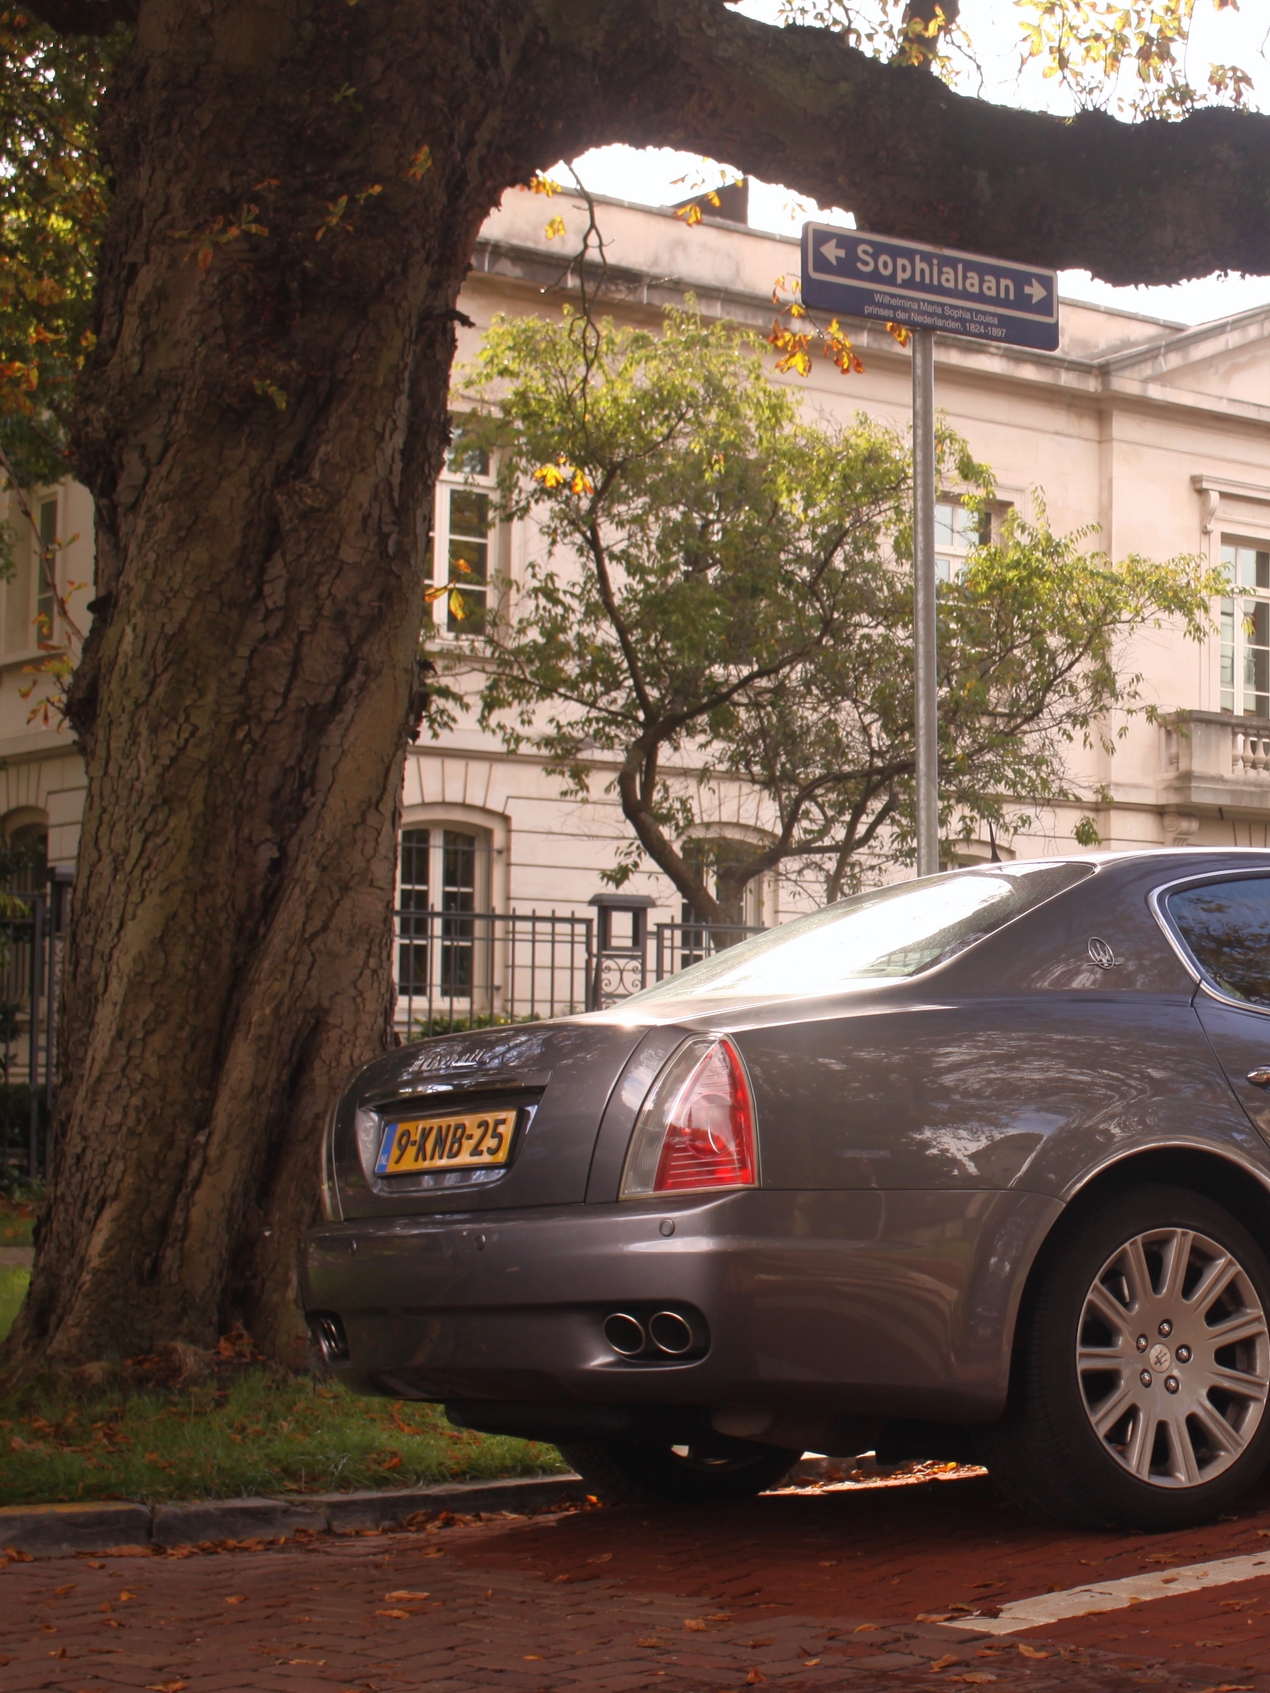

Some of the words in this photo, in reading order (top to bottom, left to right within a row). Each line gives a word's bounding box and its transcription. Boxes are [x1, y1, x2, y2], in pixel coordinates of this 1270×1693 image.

[856, 244, 1015, 301] Sophialaan
[864, 304, 894, 318] prinses
[895, 310, 910, 320] der
[911, 311, 964, 332] Nederlanden,
[966, 322, 1007, 338] 1824-1897
[873, 292, 919, 309] Wilhelmina
[920, 301, 943, 315] Maria
[944, 305, 972, 319] Sophia
[973, 311, 999, 325] Louisa
[394, 1117, 507, 1165] 9-KNB-25
[379, 1153, 388, 1166] NL
